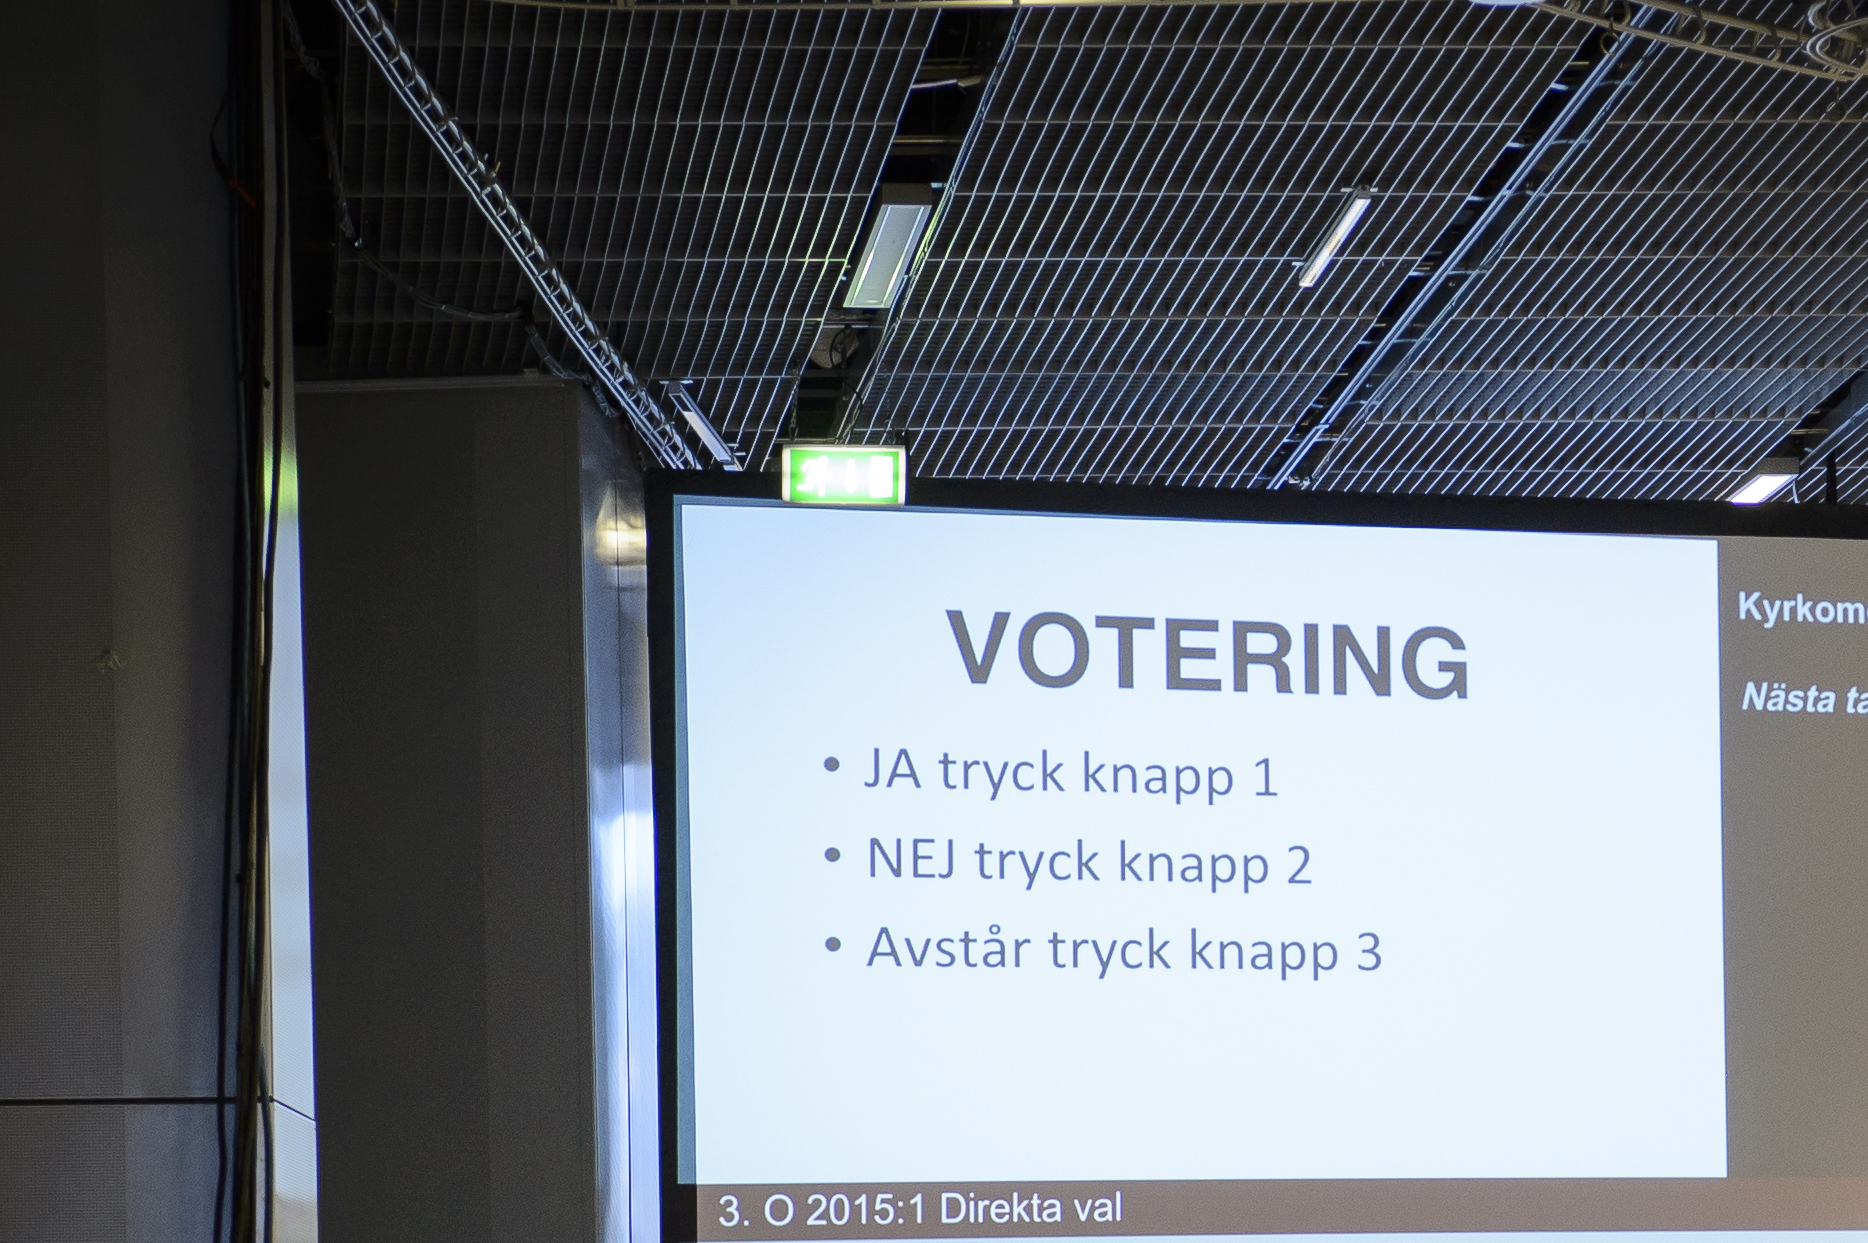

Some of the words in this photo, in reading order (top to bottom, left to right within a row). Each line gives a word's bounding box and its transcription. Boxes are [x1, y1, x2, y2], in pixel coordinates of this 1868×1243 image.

[945, 609, 1468, 701] VOTERING
[1741, 681, 1836, 713] Nästa
[864, 747, 922, 789] JA
[938, 750, 1066, 801] tryck
[1083, 750, 1234, 806] knapp
[1254, 757, 1279, 797] 1
[868, 837, 954, 880] NEJ
[974, 839, 1101, 891] tryck
[1119, 839, 1270, 894] knapp
[1287, 845, 1313, 884] 2
[866, 923, 1032, 968] Avstår
[1047, 927, 1172, 979] tryck
[1190, 927, 1339, 981] knapp
[1357, 932, 1383, 972] 3
[718, 1194, 750, 1228] 3.
[764, 1193, 795, 1227] O
[805, 1192, 924, 1226] 2015:1
[941, 1191, 1062, 1225] Direkta
[1073, 1190, 1123, 1223] val
